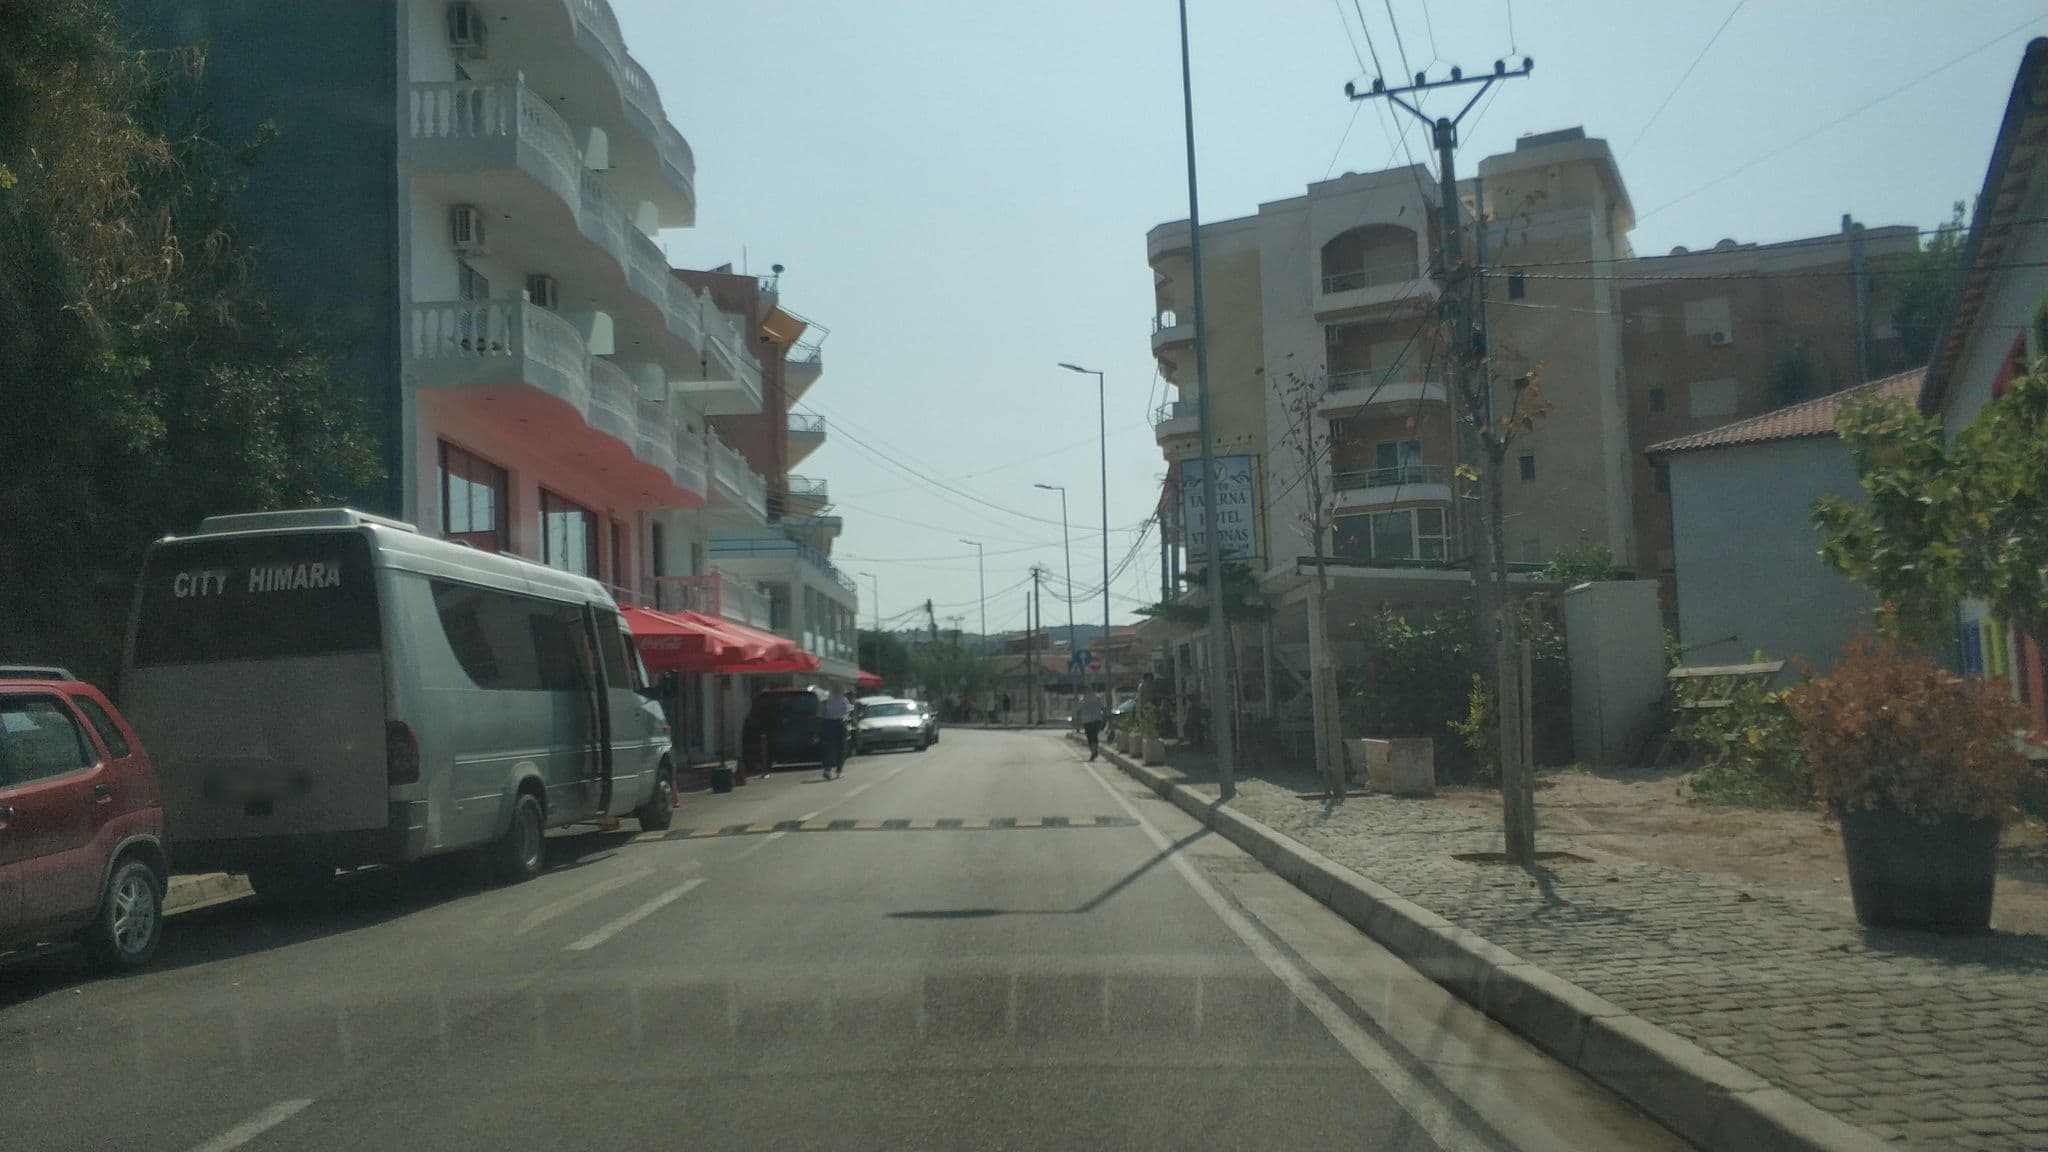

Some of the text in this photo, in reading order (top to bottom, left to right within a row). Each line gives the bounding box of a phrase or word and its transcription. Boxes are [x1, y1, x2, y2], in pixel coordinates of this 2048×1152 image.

[1191, 492, 1247, 508] TARNA
[174, 562, 341, 598] CITY HIMARA
